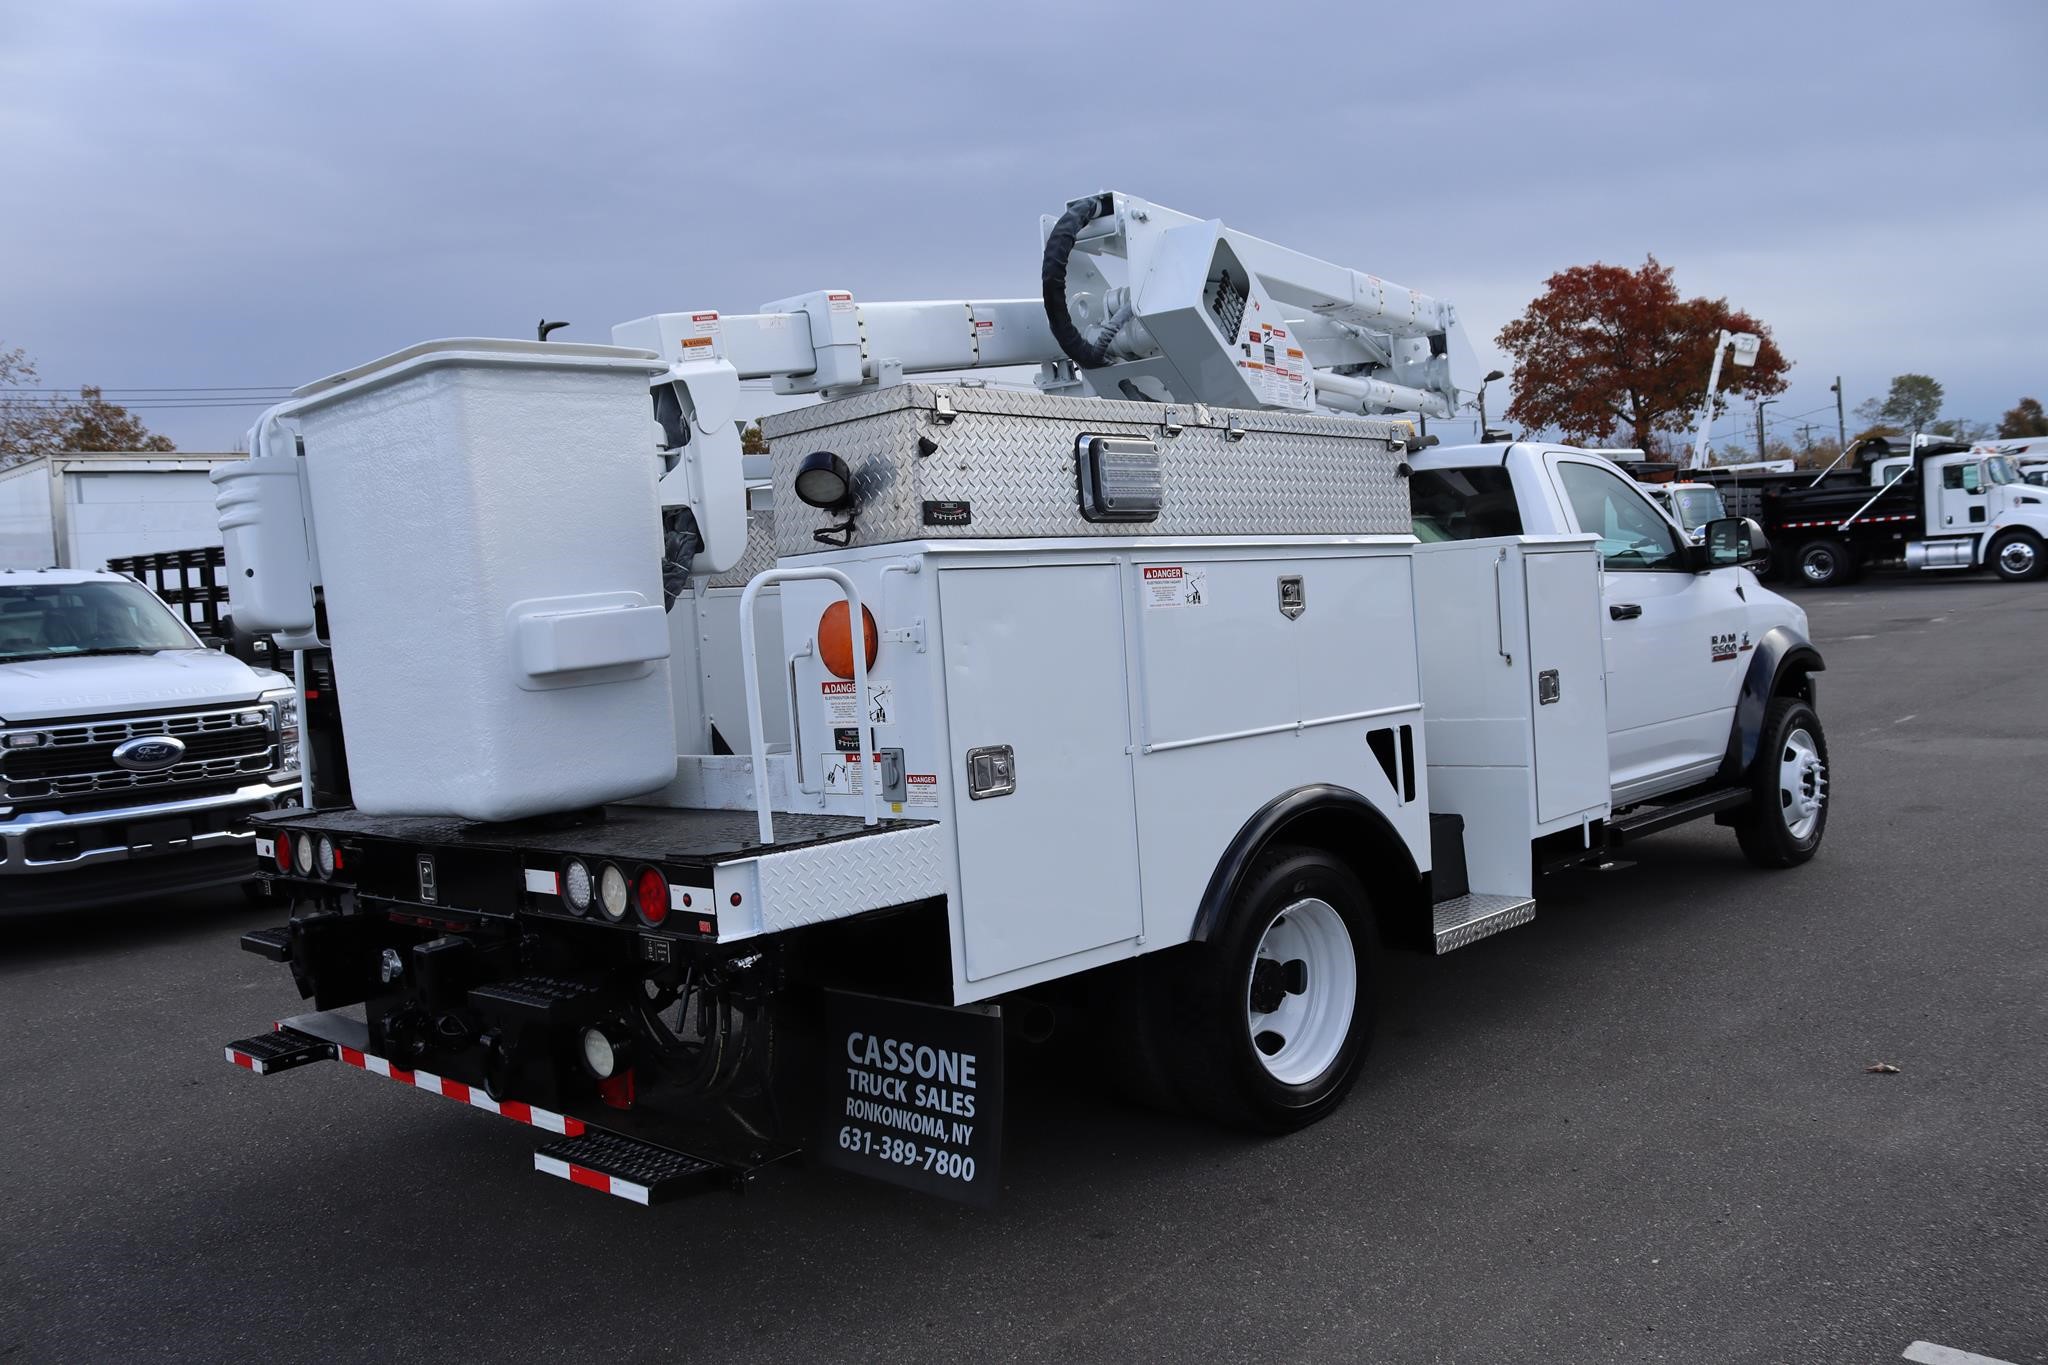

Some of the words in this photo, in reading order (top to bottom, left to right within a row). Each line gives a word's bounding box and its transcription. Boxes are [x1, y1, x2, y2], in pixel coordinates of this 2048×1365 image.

[1152, 569, 1181, 578] DANGER
[1711, 633, 1737, 645] RAM
[1711, 643, 1737, 655] 5500
[830, 683, 857, 693] DANGE
[136, 744, 168, 760] Ford
[847, 1032, 977, 1089] CASSONE
[847, 1068, 908, 1103] TRUCK
[915, 1083, 976, 1118] SALES
[846, 1097, 949, 1144] RONKONKOMA,
[952, 1122, 974, 1146] NY
[839, 1126, 976, 1182] 631-389-7800
